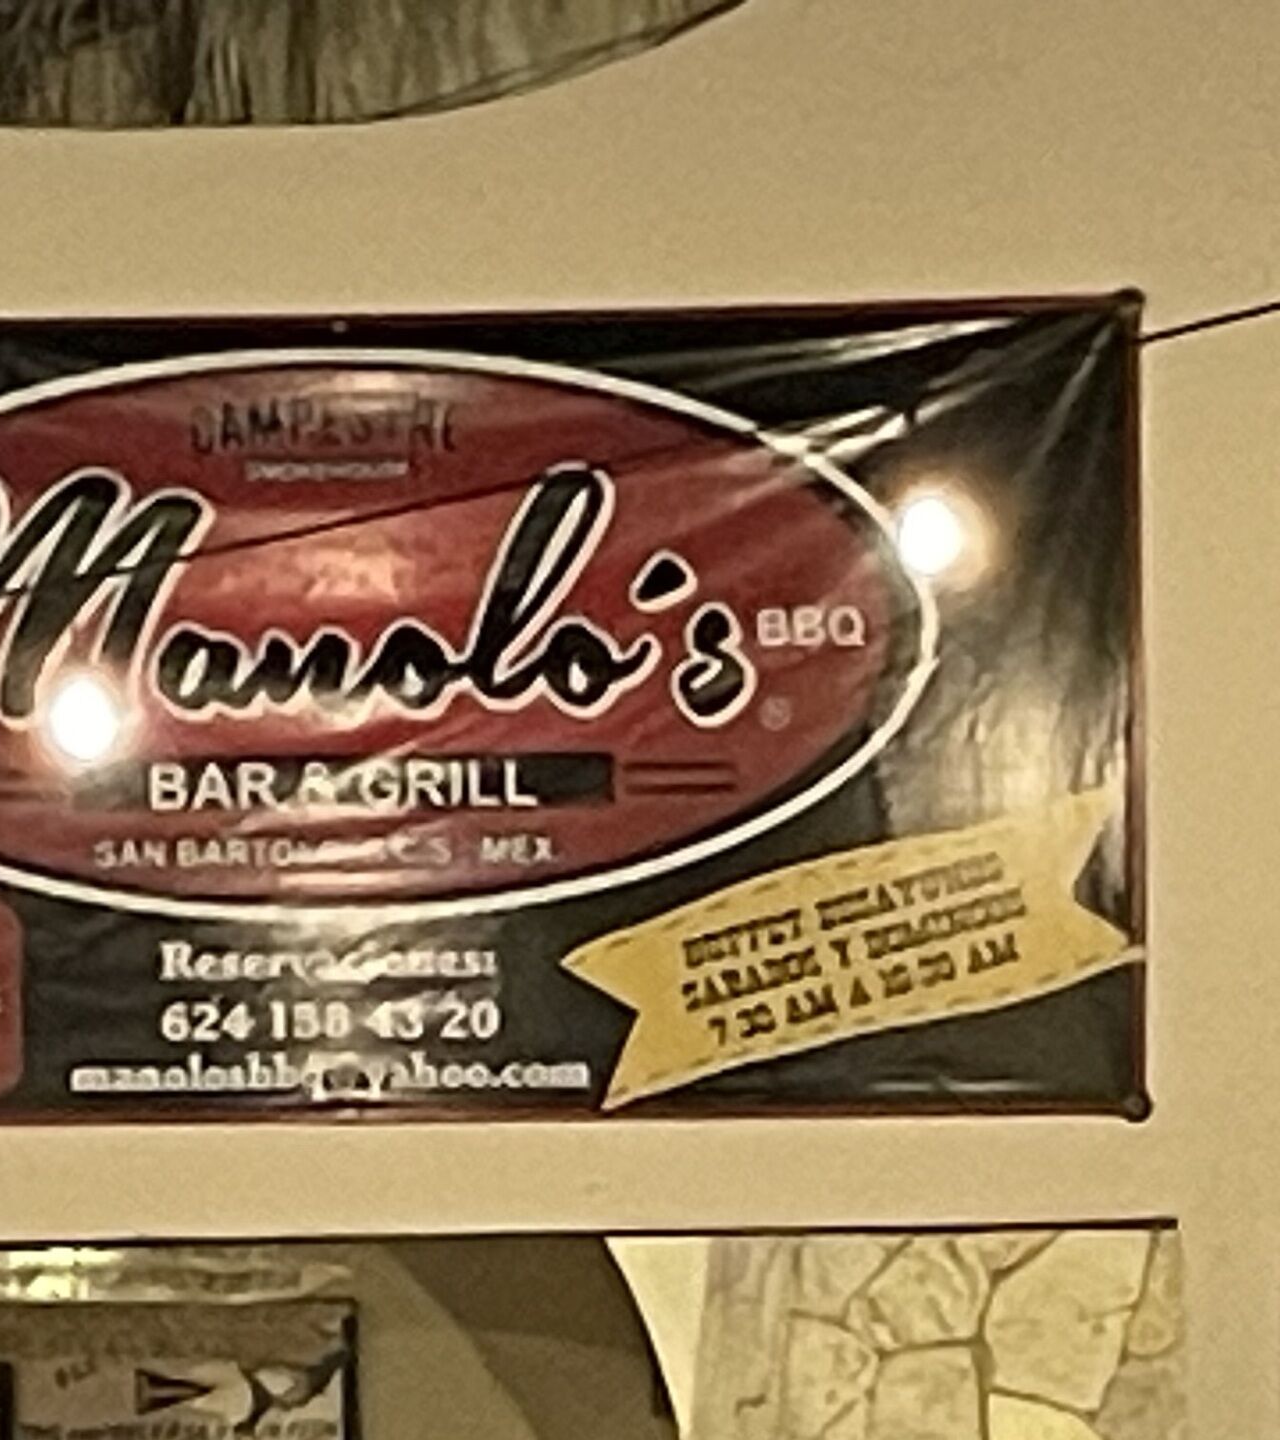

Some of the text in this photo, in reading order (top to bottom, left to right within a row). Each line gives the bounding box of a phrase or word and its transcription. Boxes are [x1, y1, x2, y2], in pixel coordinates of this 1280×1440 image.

[757, 605, 865, 646] BBQ
[148, 761, 278, 812] BAR
[358, 759, 538, 808] GRILL
[93, 840, 167, 868] SAN
[175, 838, 342, 868] BARTO
[158, 941, 497, 983] Reservaones:
[829, 937, 852, 969] Y
[786, 983, 840, 1025] AM
[849, 977, 873, 1009] A
[967, 932, 1022, 975] AM
[160, 1002, 255, 1041] 624
[439, 999, 503, 1038] 20
